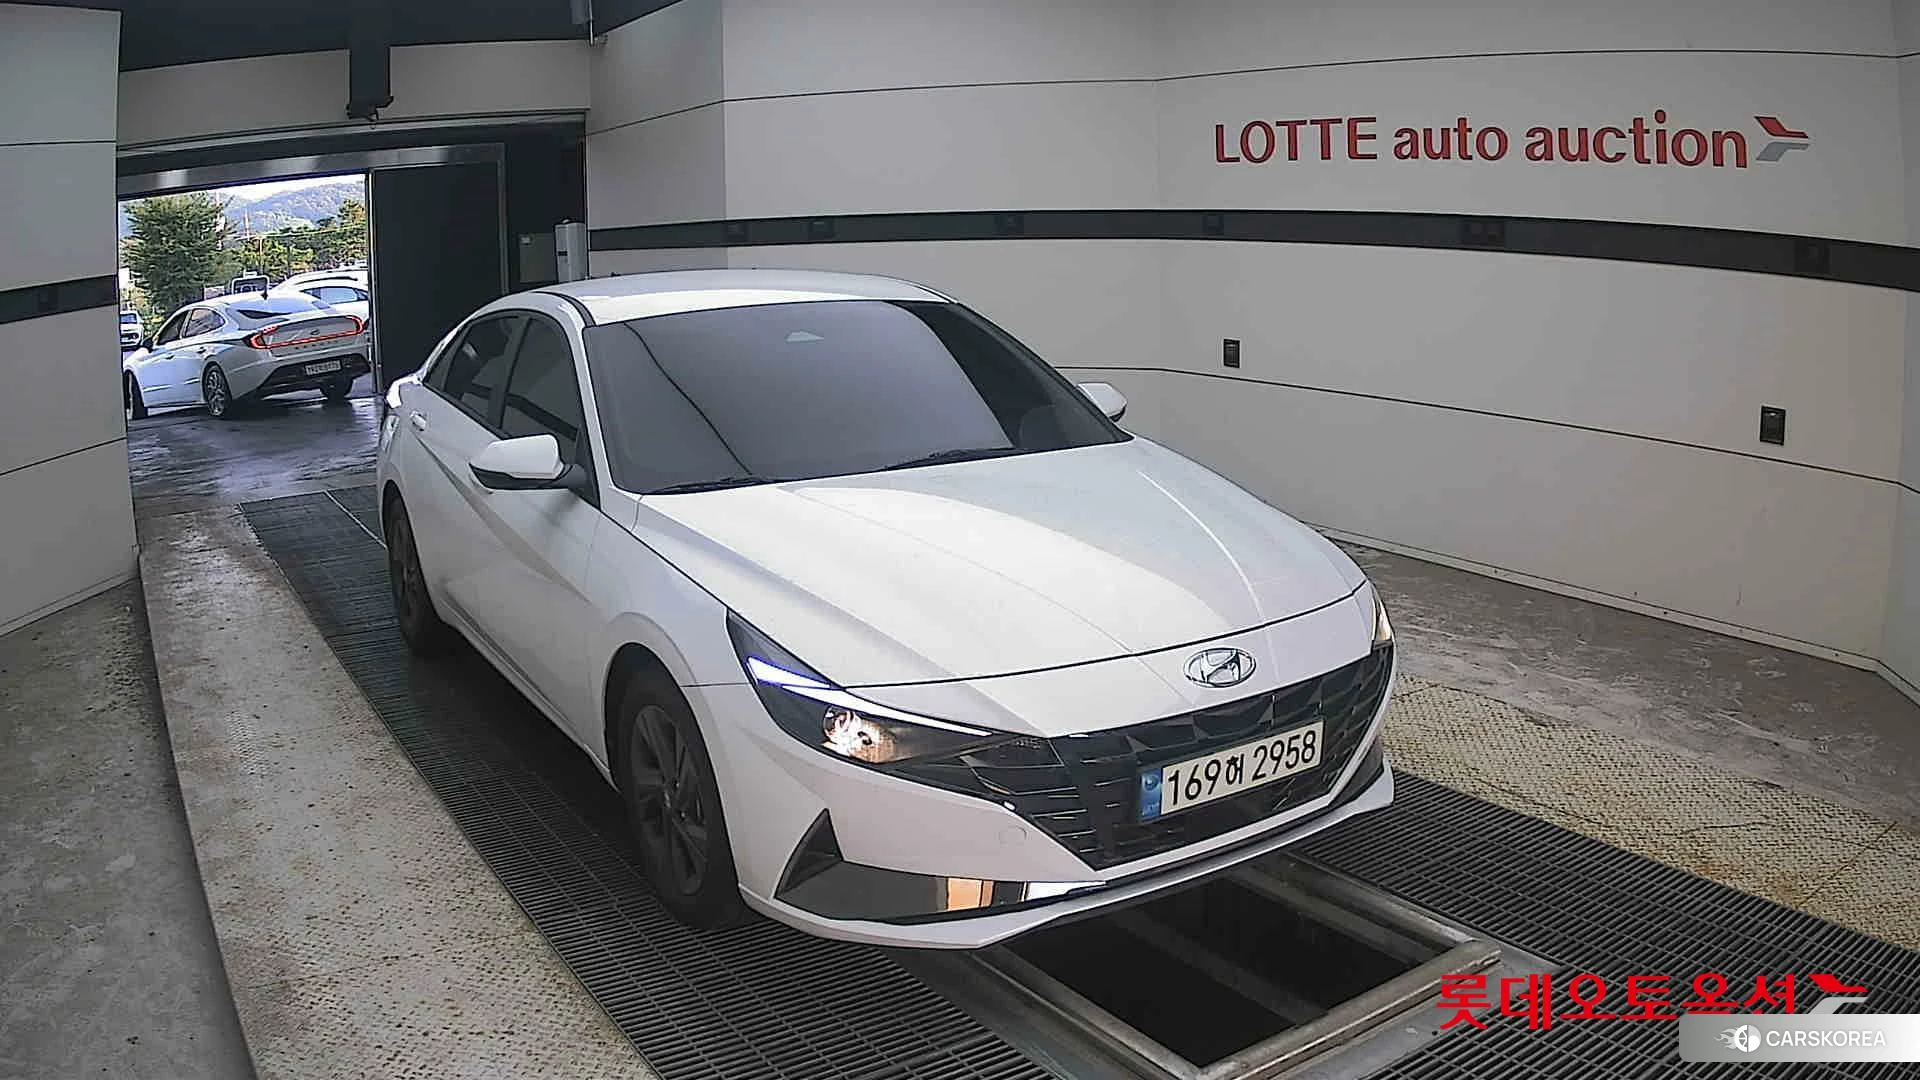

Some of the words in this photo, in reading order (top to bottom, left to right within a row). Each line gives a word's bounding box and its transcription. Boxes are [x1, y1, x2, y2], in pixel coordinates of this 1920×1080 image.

[1214, 116, 1378, 163] LOTTE
[1393, 117, 1509, 161] auto
[1524, 109, 1748, 168] auction
[1251, 730, 1317, 782] 2958
